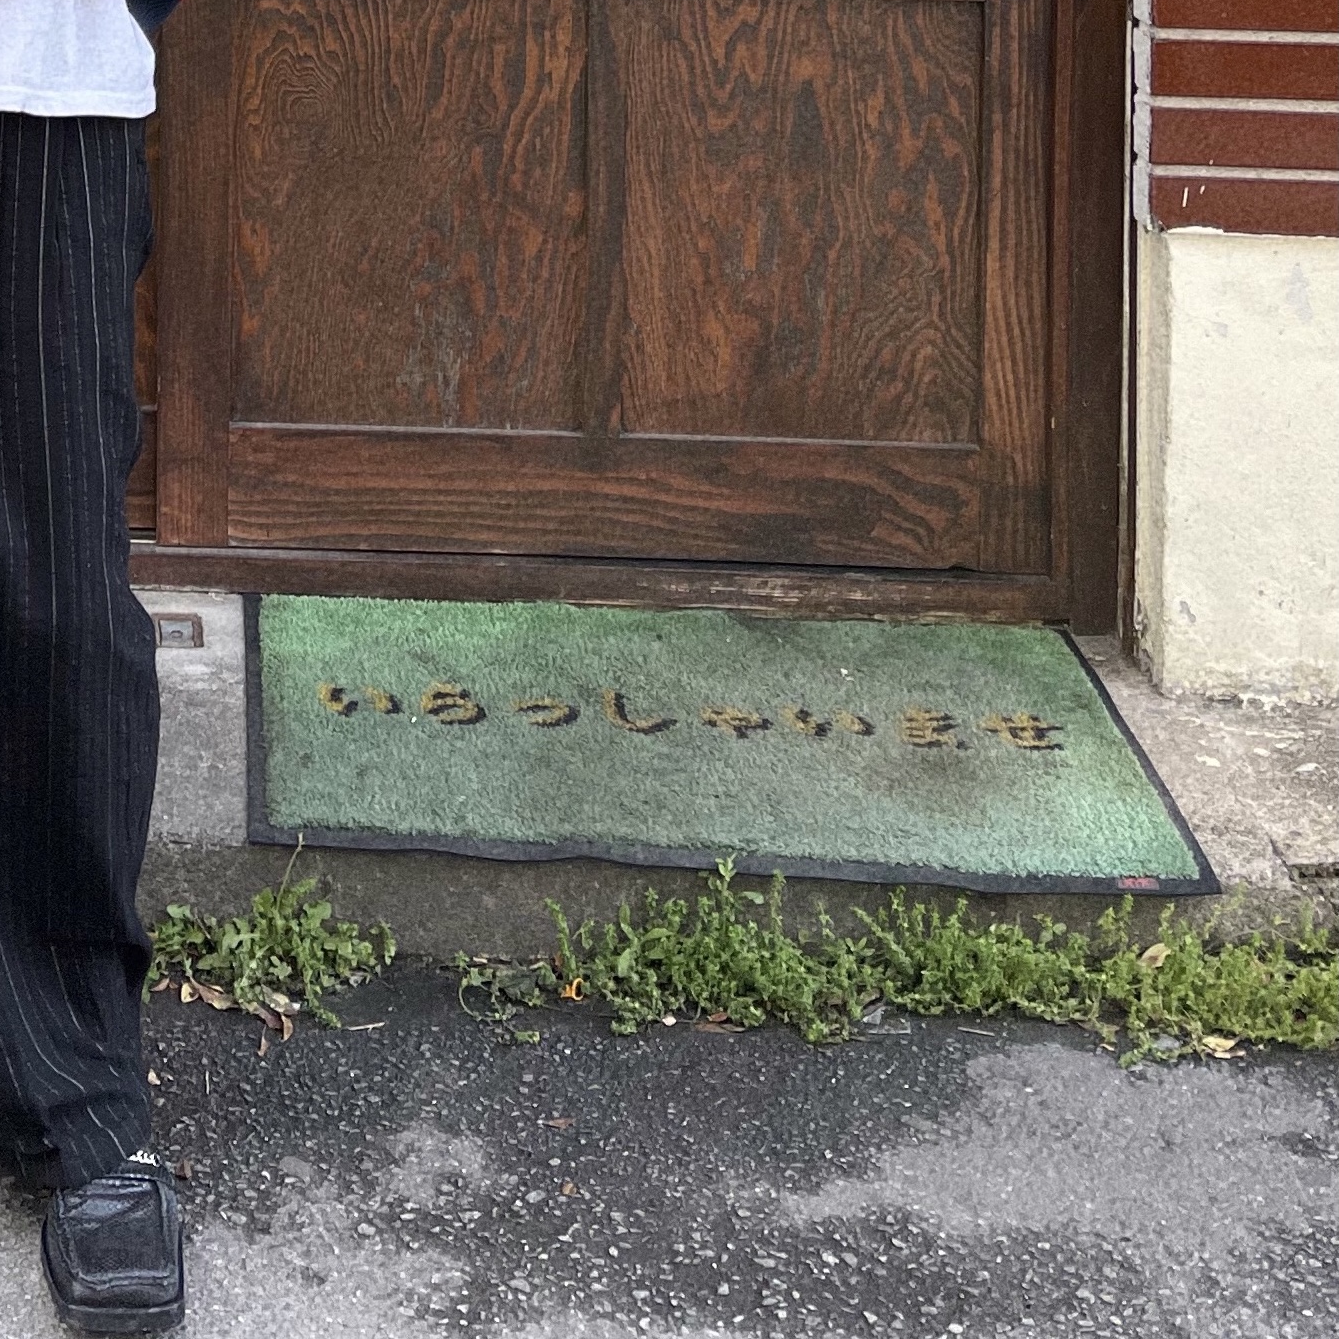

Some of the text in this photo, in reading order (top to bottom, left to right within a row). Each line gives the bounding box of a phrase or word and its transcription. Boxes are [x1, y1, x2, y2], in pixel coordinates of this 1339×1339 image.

[317, 681, 1065, 751] いらっしゃいませ
